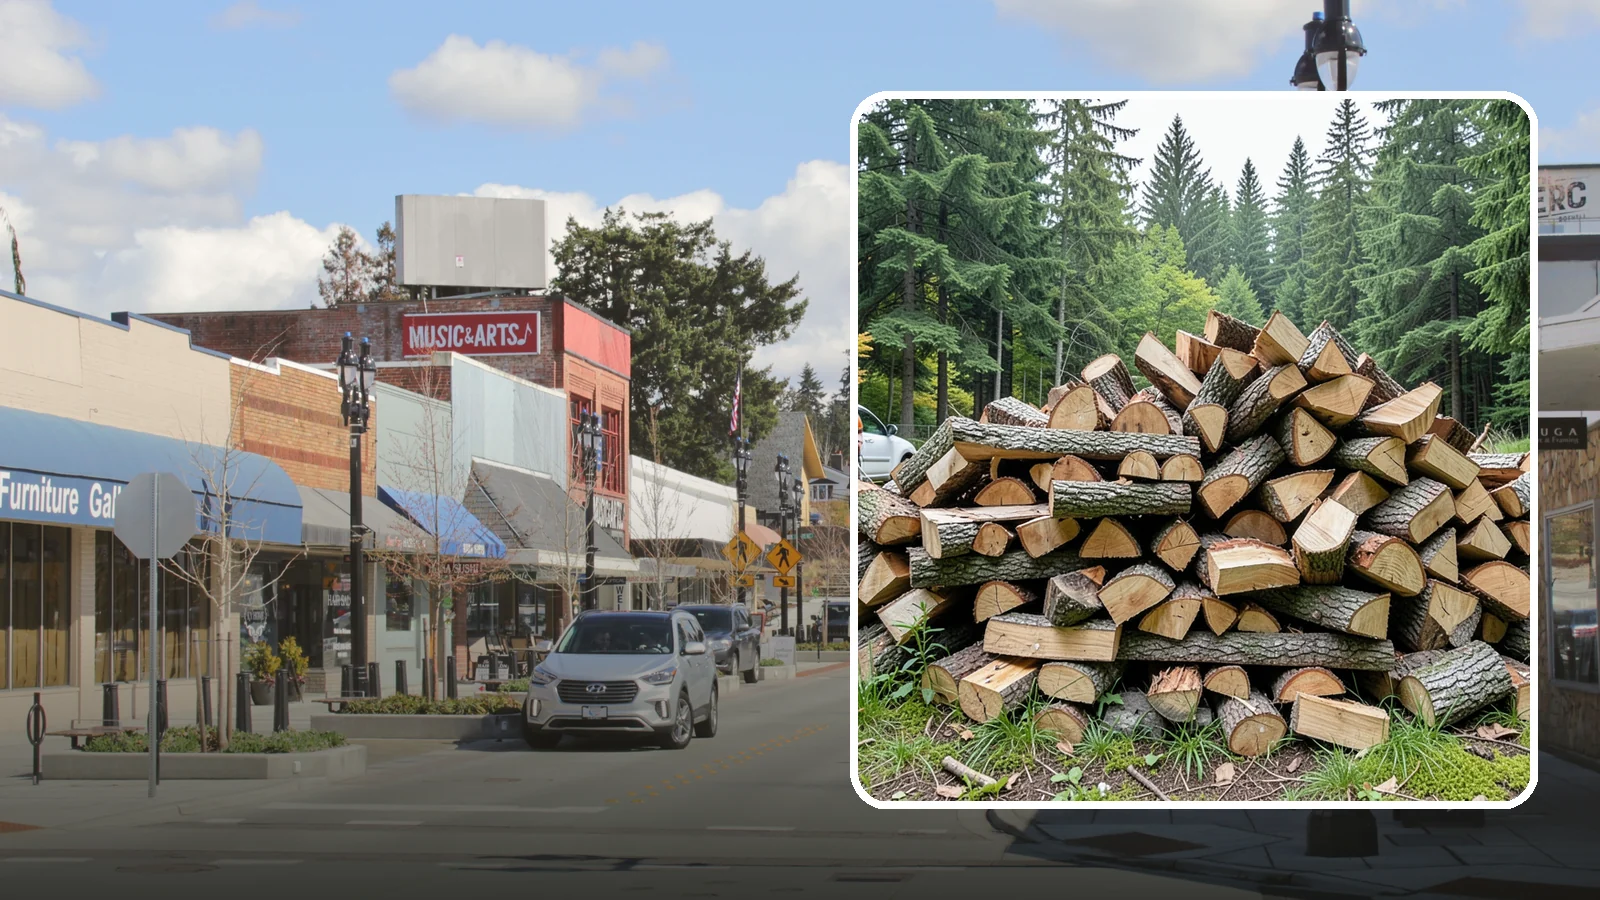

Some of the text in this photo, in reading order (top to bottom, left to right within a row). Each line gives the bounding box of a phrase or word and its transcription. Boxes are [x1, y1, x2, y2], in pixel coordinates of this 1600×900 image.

[408, 322, 520, 348] MUSIC&ARTS
[1551, 436, 1579, 444] Framing
[0, 471, 122, 519] Furniture Gal
[453, 563, 479, 574] SUSHI
